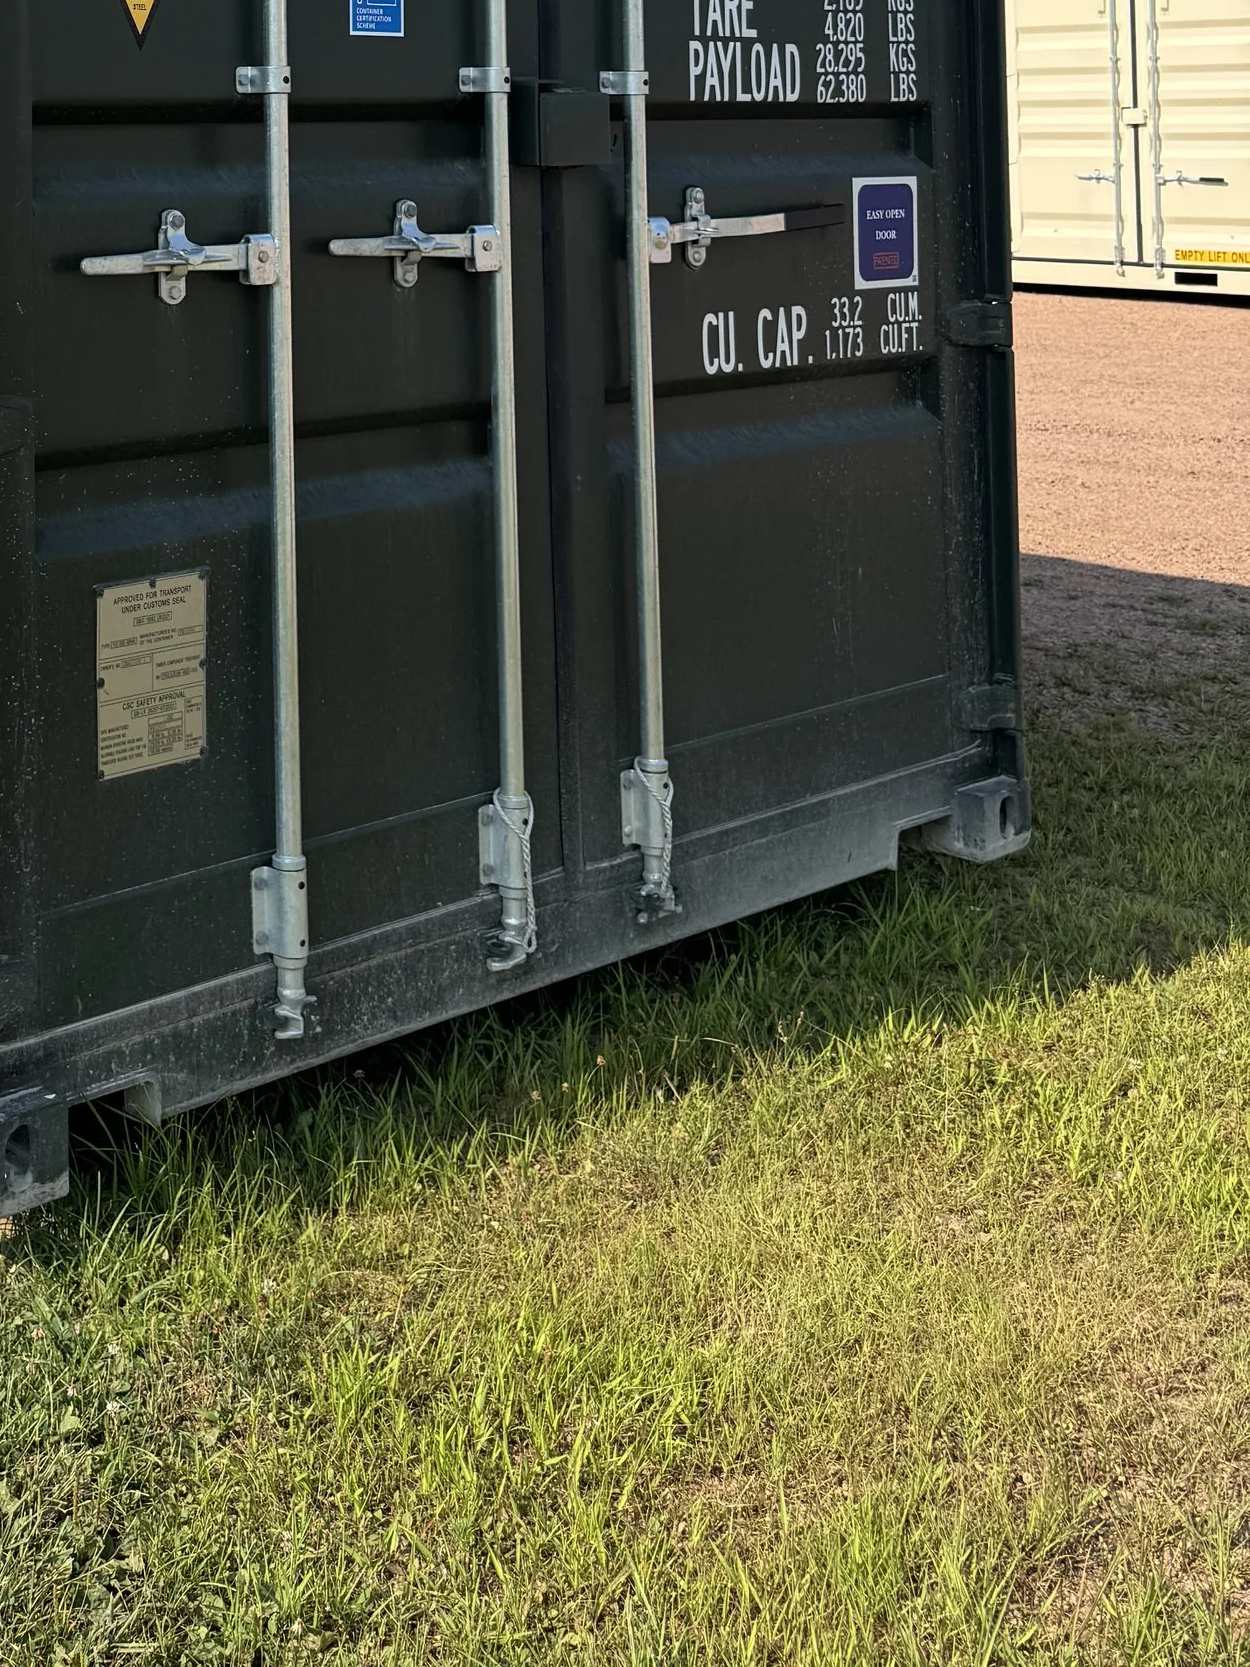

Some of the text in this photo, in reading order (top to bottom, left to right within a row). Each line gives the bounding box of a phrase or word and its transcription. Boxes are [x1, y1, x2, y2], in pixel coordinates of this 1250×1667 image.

[356, 7, 384, 15] CONTAINER
[824, 12, 915, 43] 4,820 LBS
[689, 41, 916, 102] PAYLOAD 28,295 KGS
[817, 74, 917, 104] 62,380 LBS
[866, 208, 906, 220] EASY OPEN
[875, 230, 897, 240] DOOR
[1175, 250, 1250, 264] EMPTY LIFT ONL
[702, 291, 922, 375] CU. CAP. 33.2 CU.M.
[825, 322, 923, 360] 1,173 CU.FT.
[113, 584, 192, 606] APPROVED FOR TRANSPORT
[122, 596, 186, 614] UNDER CUSTOMS SEAL
[122, 702, 135, 711] CSC
[136, 696, 156, 708] SAFETY
[158, 690, 186, 703] APPROVAL
